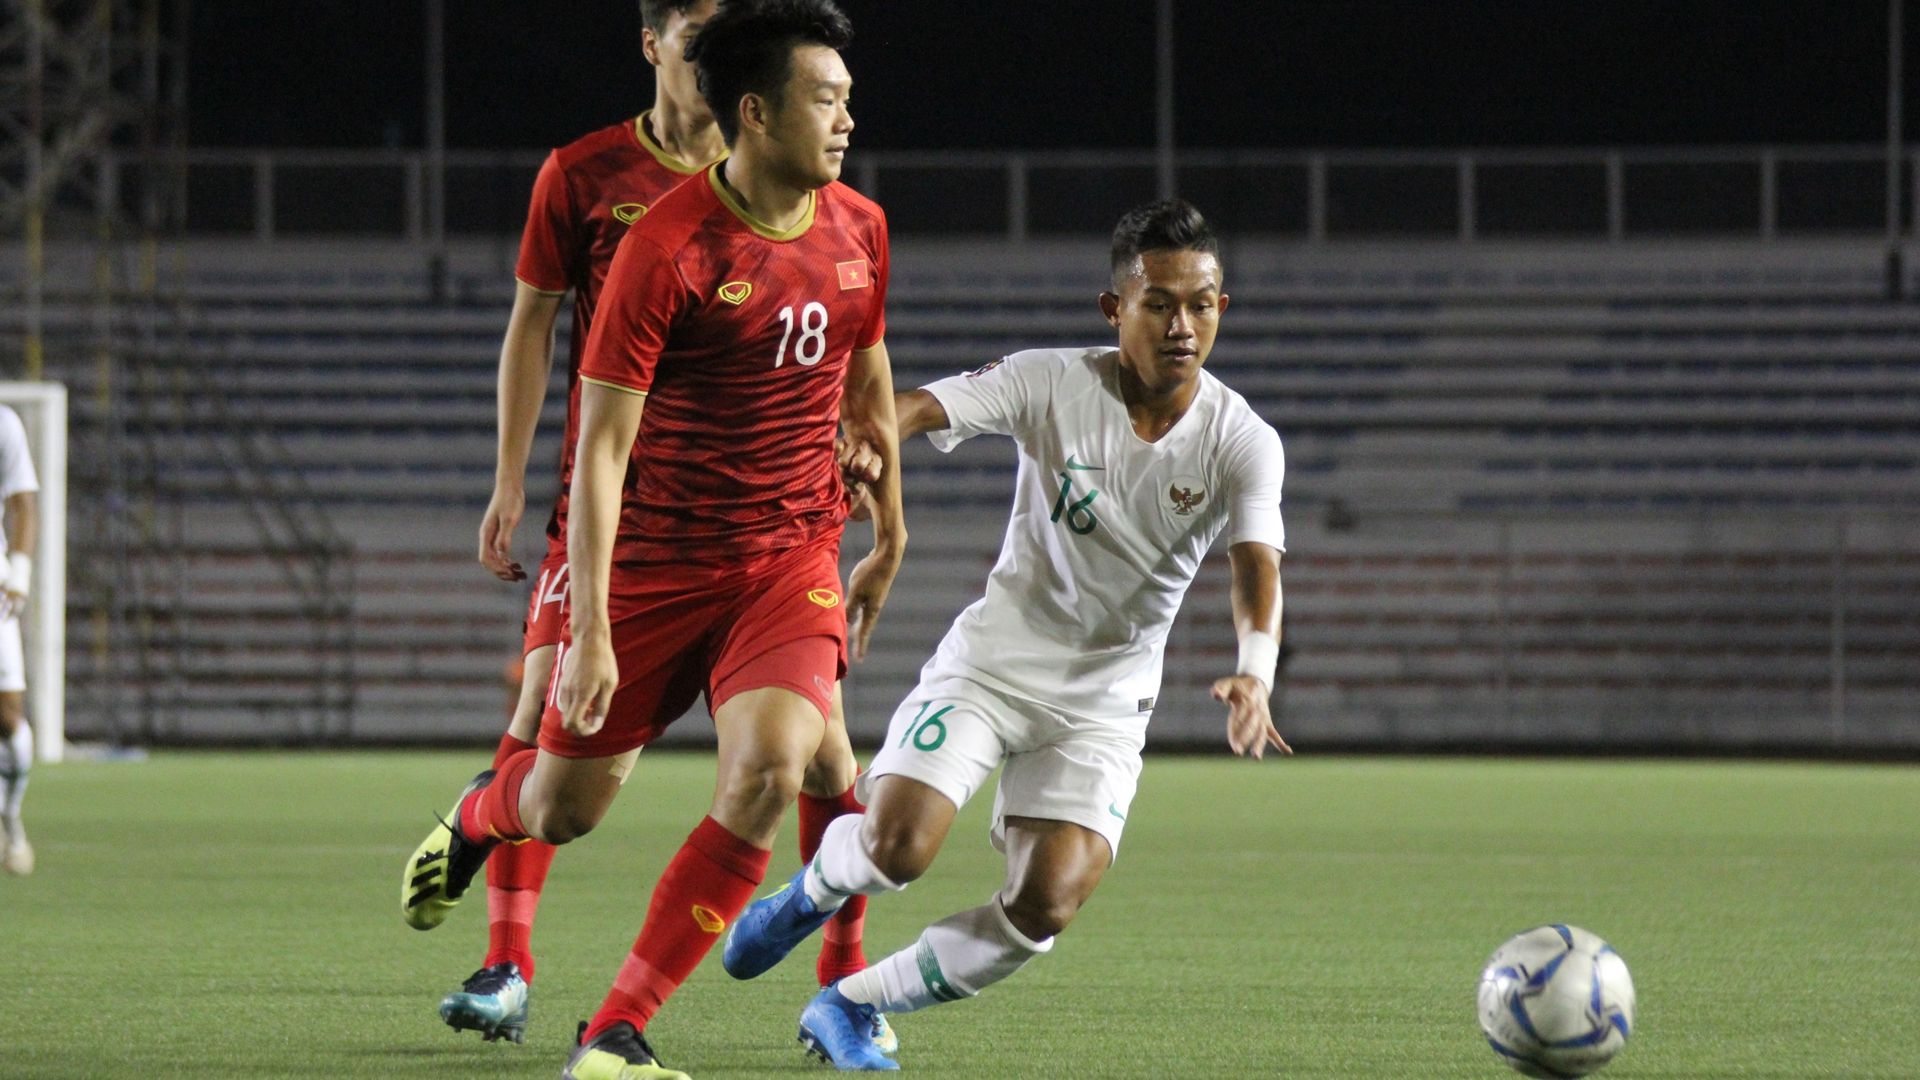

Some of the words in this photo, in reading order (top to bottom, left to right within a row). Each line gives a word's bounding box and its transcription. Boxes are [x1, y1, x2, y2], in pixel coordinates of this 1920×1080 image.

[775, 301, 828, 368] 18
[1050, 472, 1098, 534] 16
[533, 563, 570, 622] 14
[899, 700, 955, 752] 16
